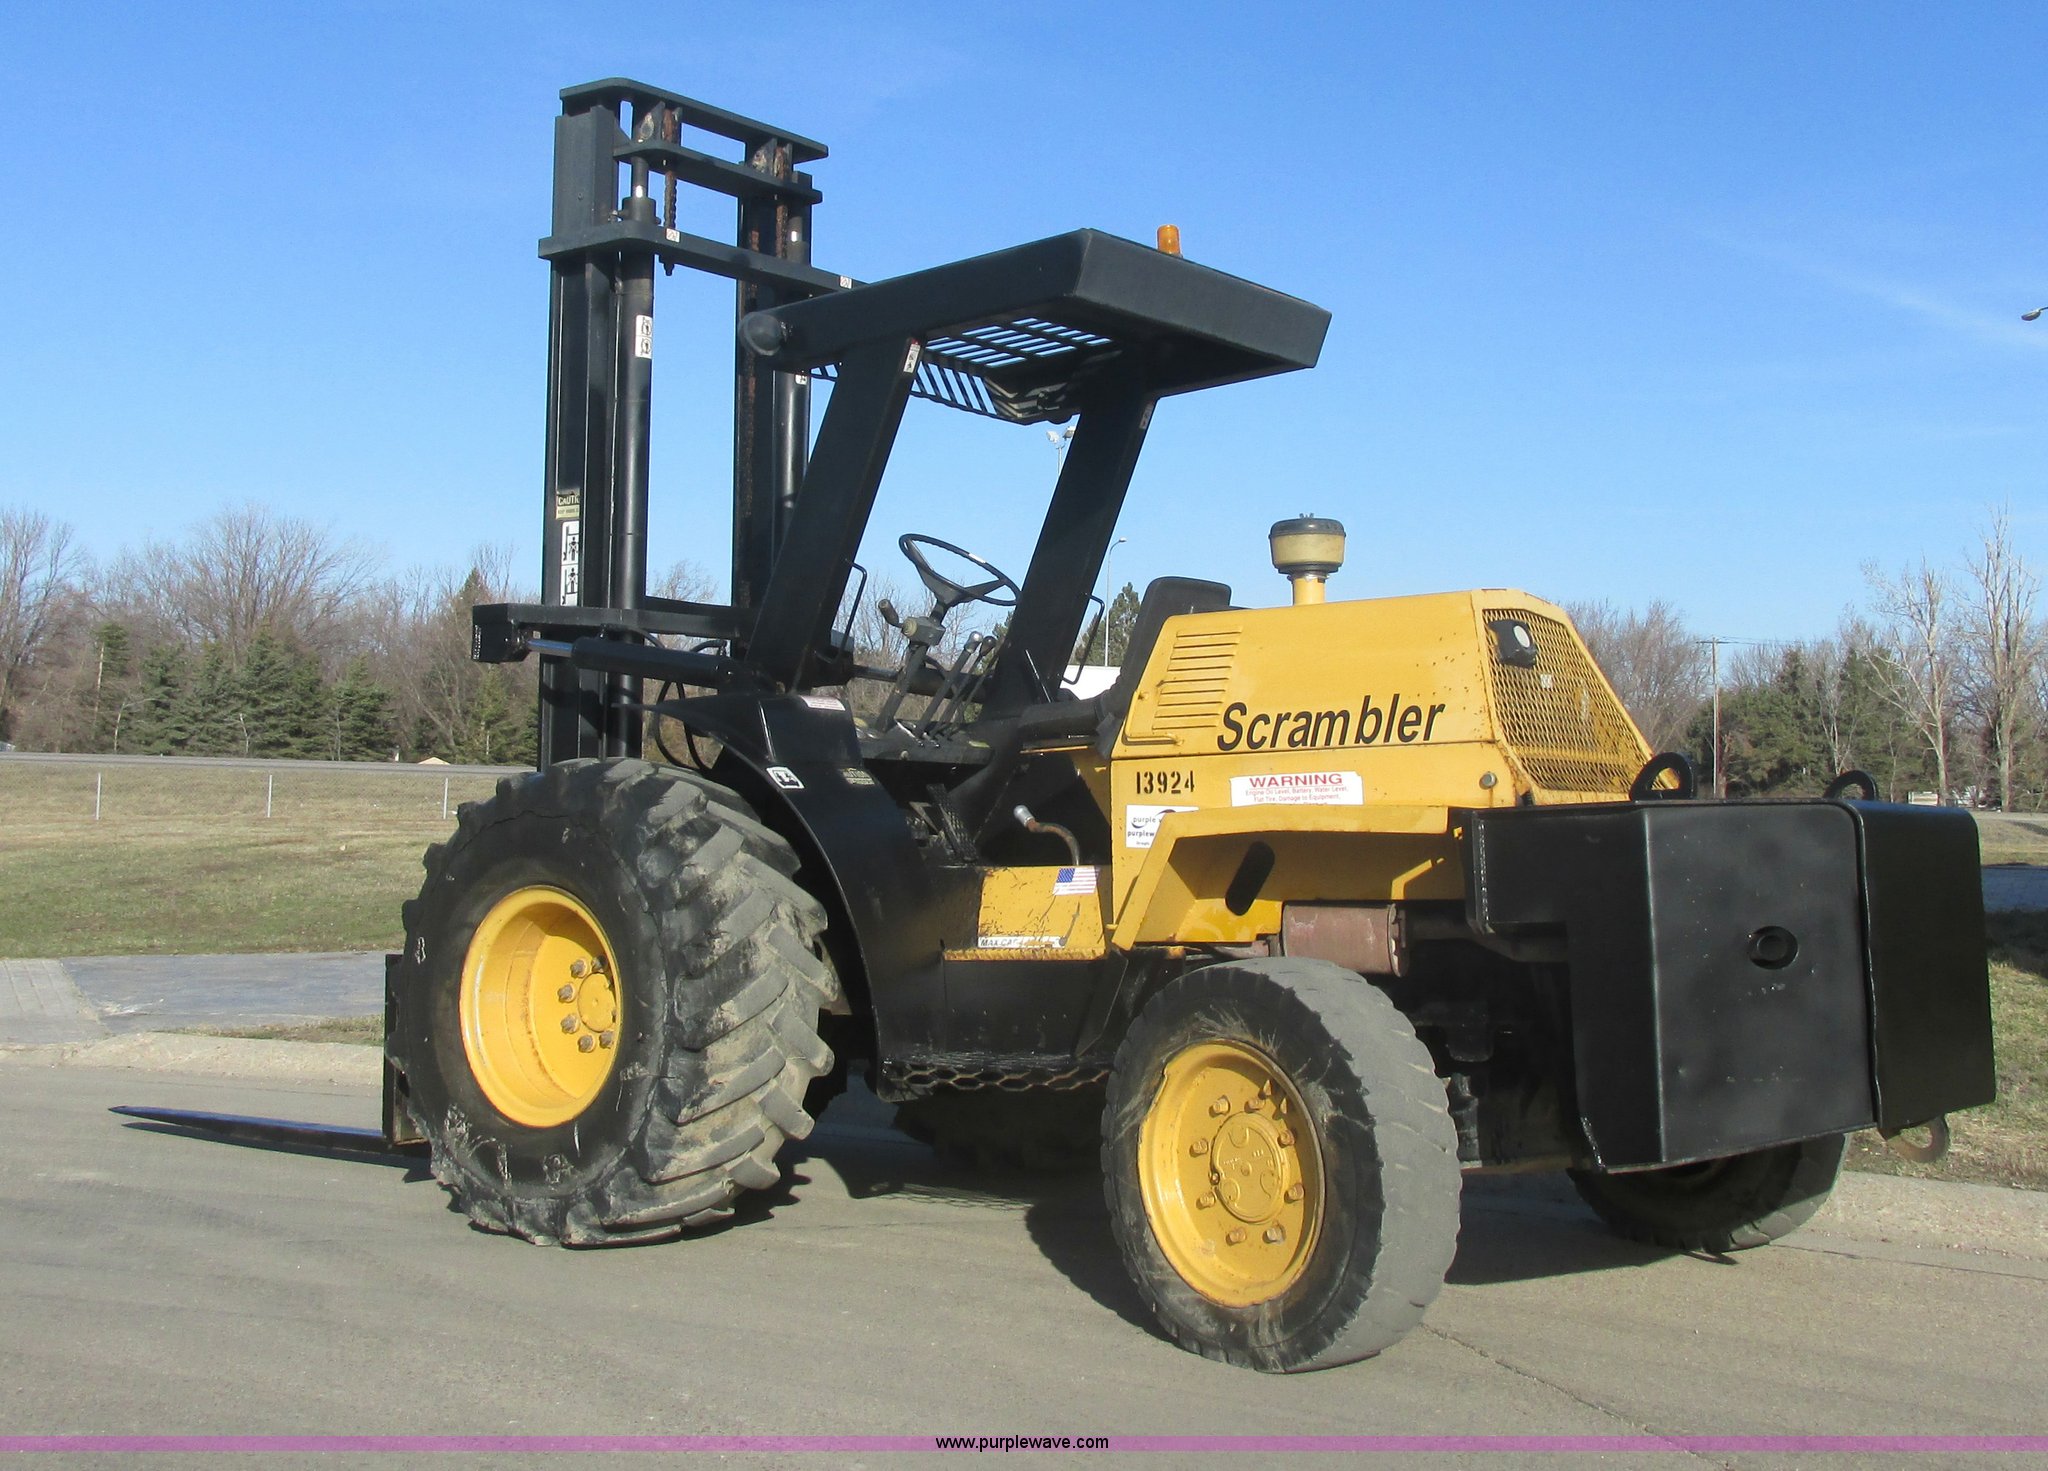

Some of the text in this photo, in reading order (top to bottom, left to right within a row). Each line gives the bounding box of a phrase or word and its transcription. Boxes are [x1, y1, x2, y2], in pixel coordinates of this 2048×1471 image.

[1217, 693, 1446, 751] Scrambler
[1136, 770, 1195, 795] 13924
[1249, 773, 1343, 788] WARNING
[1133, 817, 1156, 825] purple
